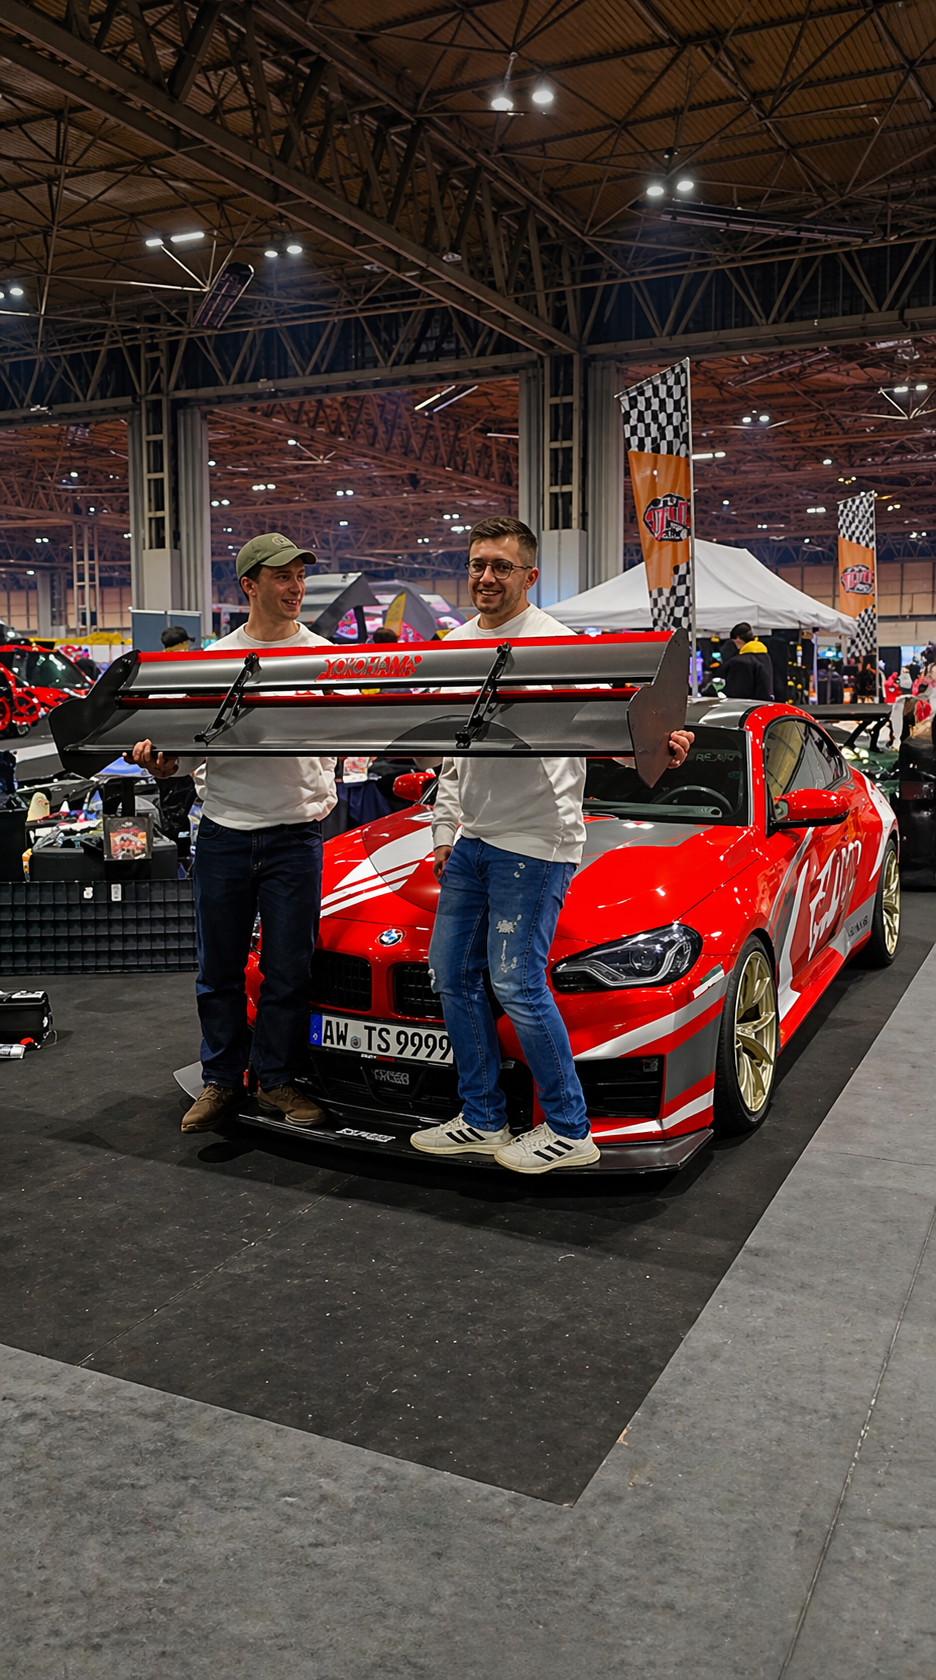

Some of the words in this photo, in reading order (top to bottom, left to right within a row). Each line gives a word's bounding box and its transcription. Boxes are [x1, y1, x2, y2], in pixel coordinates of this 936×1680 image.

[323, 1020, 348, 1046] AW
[364, 1025, 390, 1053] TS
[396, 1030, 451, 1060] 9999
